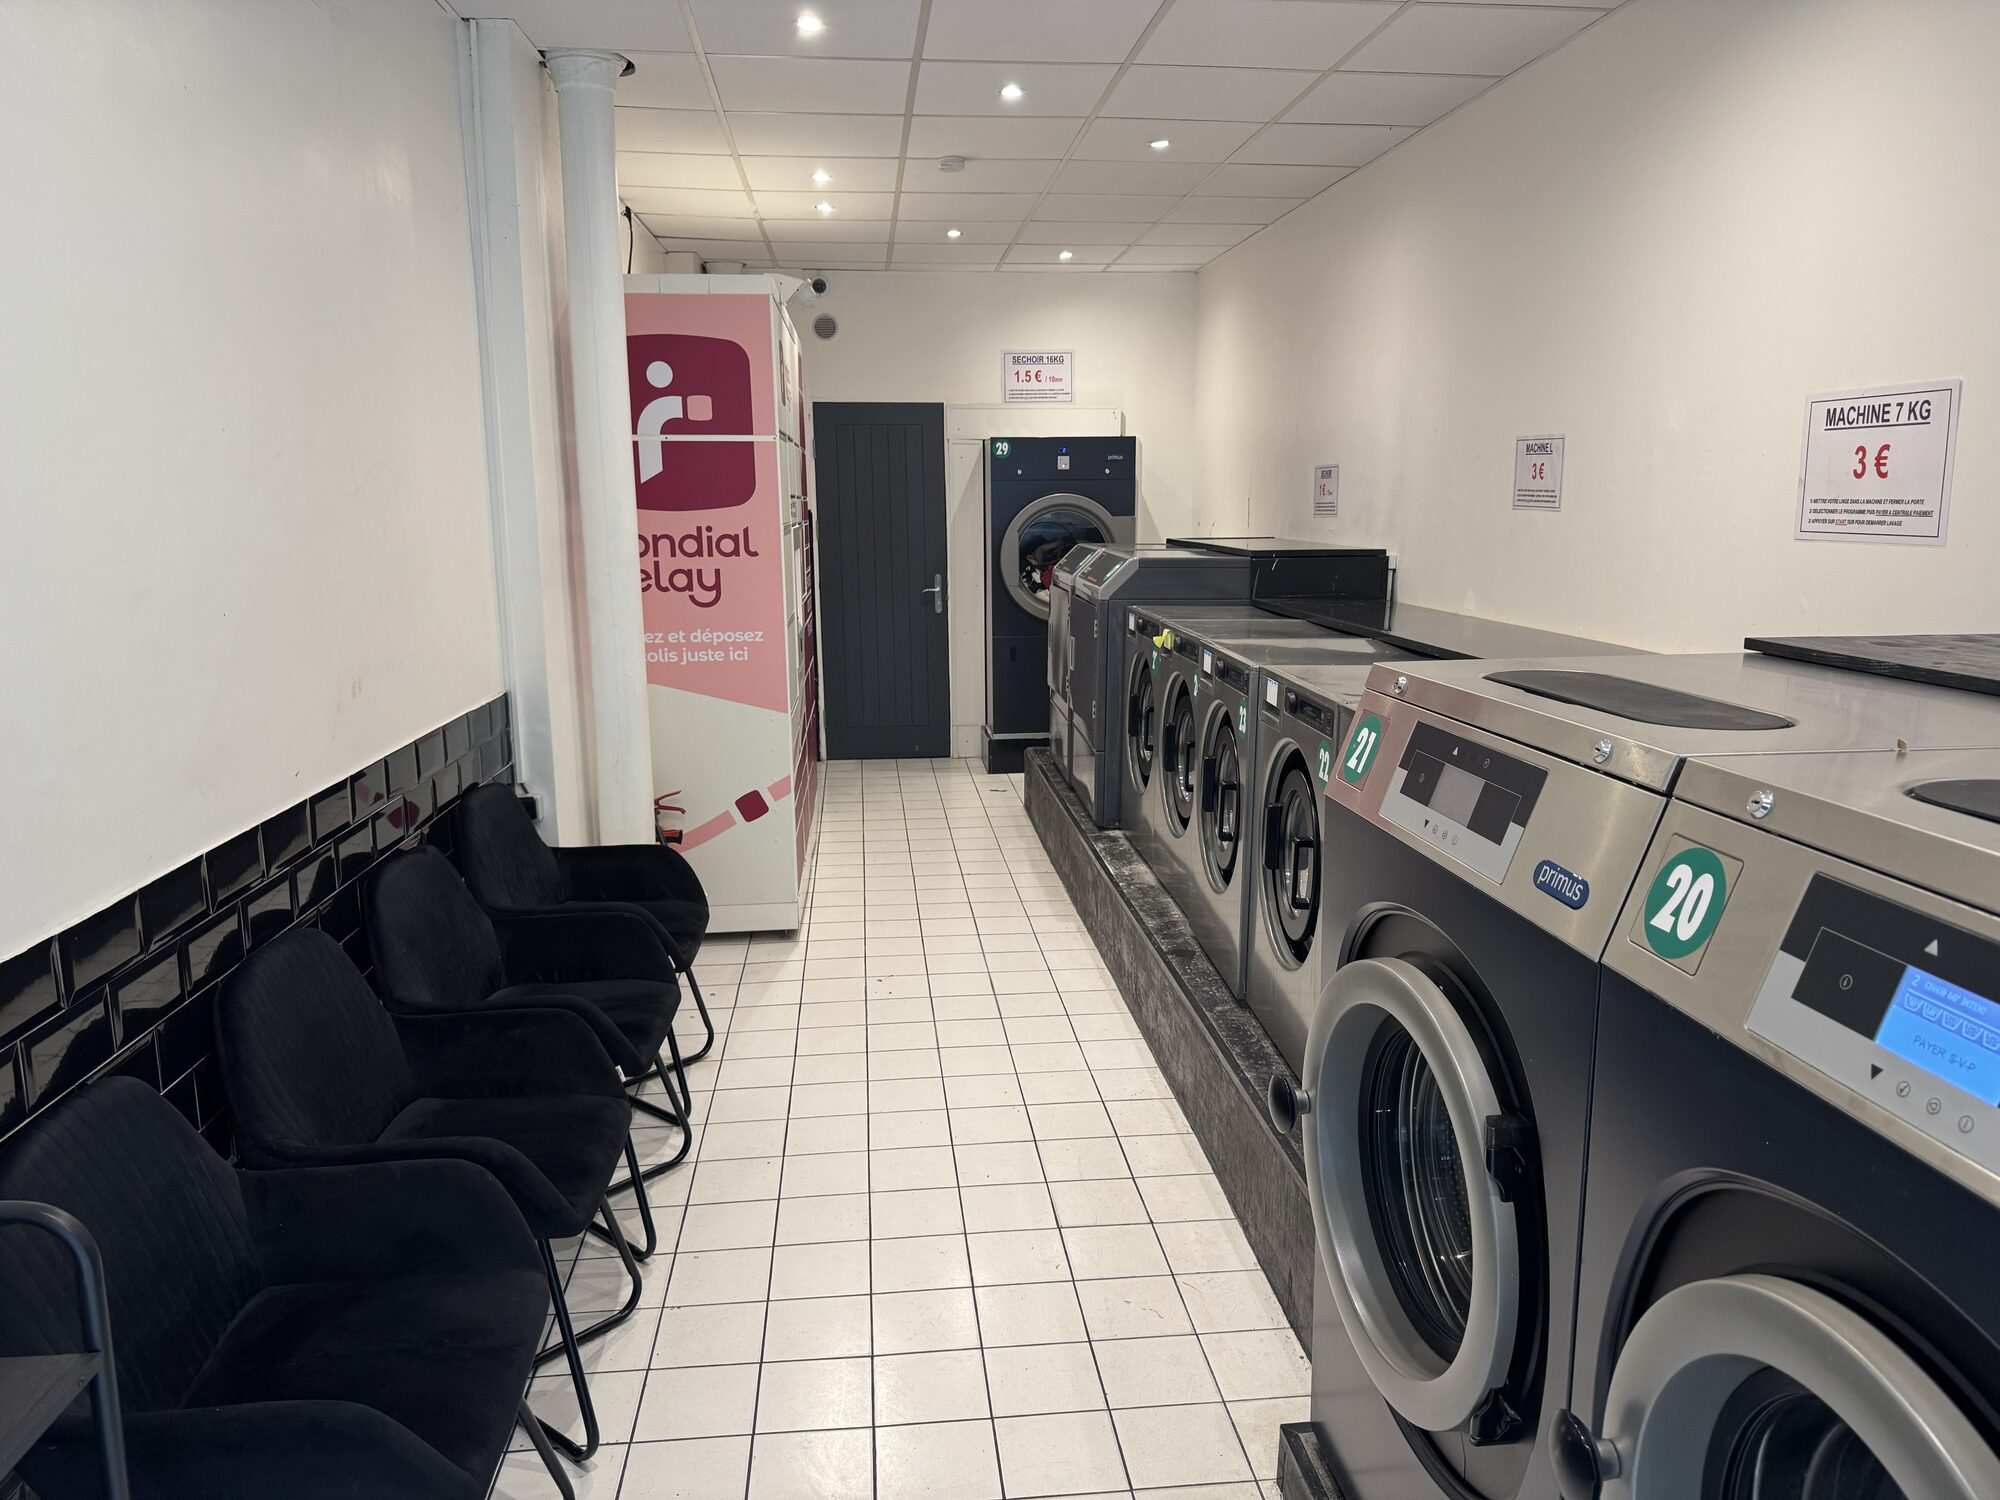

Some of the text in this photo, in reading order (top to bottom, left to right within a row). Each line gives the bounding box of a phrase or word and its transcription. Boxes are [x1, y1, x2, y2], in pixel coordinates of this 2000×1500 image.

[1012, 355, 1064, 364] SECHOIR 16KG
[1014, 370, 1031, 383] 1.5
[1035, 370, 1042, 383] €
[1825, 399, 1932, 427] MACHINE 7 KG
[995, 442, 1008, 455] 29
[1526, 443, 1549, 453] MACHINE
[1853, 444, 1891, 480] 3 €
[1532, 463, 1545, 480] 3 €
[638, 525, 759, 558] ondial
[640, 560, 722, 608] elay
[645, 628, 764, 645] ez et déposez
[646, 647, 749, 665] olis juste ici
[1239, 705, 1247, 733] 23
[1346, 727, 1377, 774] 21
[1319, 748, 1330, 783] 22
[1537, 864, 1584, 901] primus
[1649, 864, 1714, 941] 20
[1911, 974, 1920, 986] 2
[1913, 1034, 1976, 1073] PAYER S-V-P
